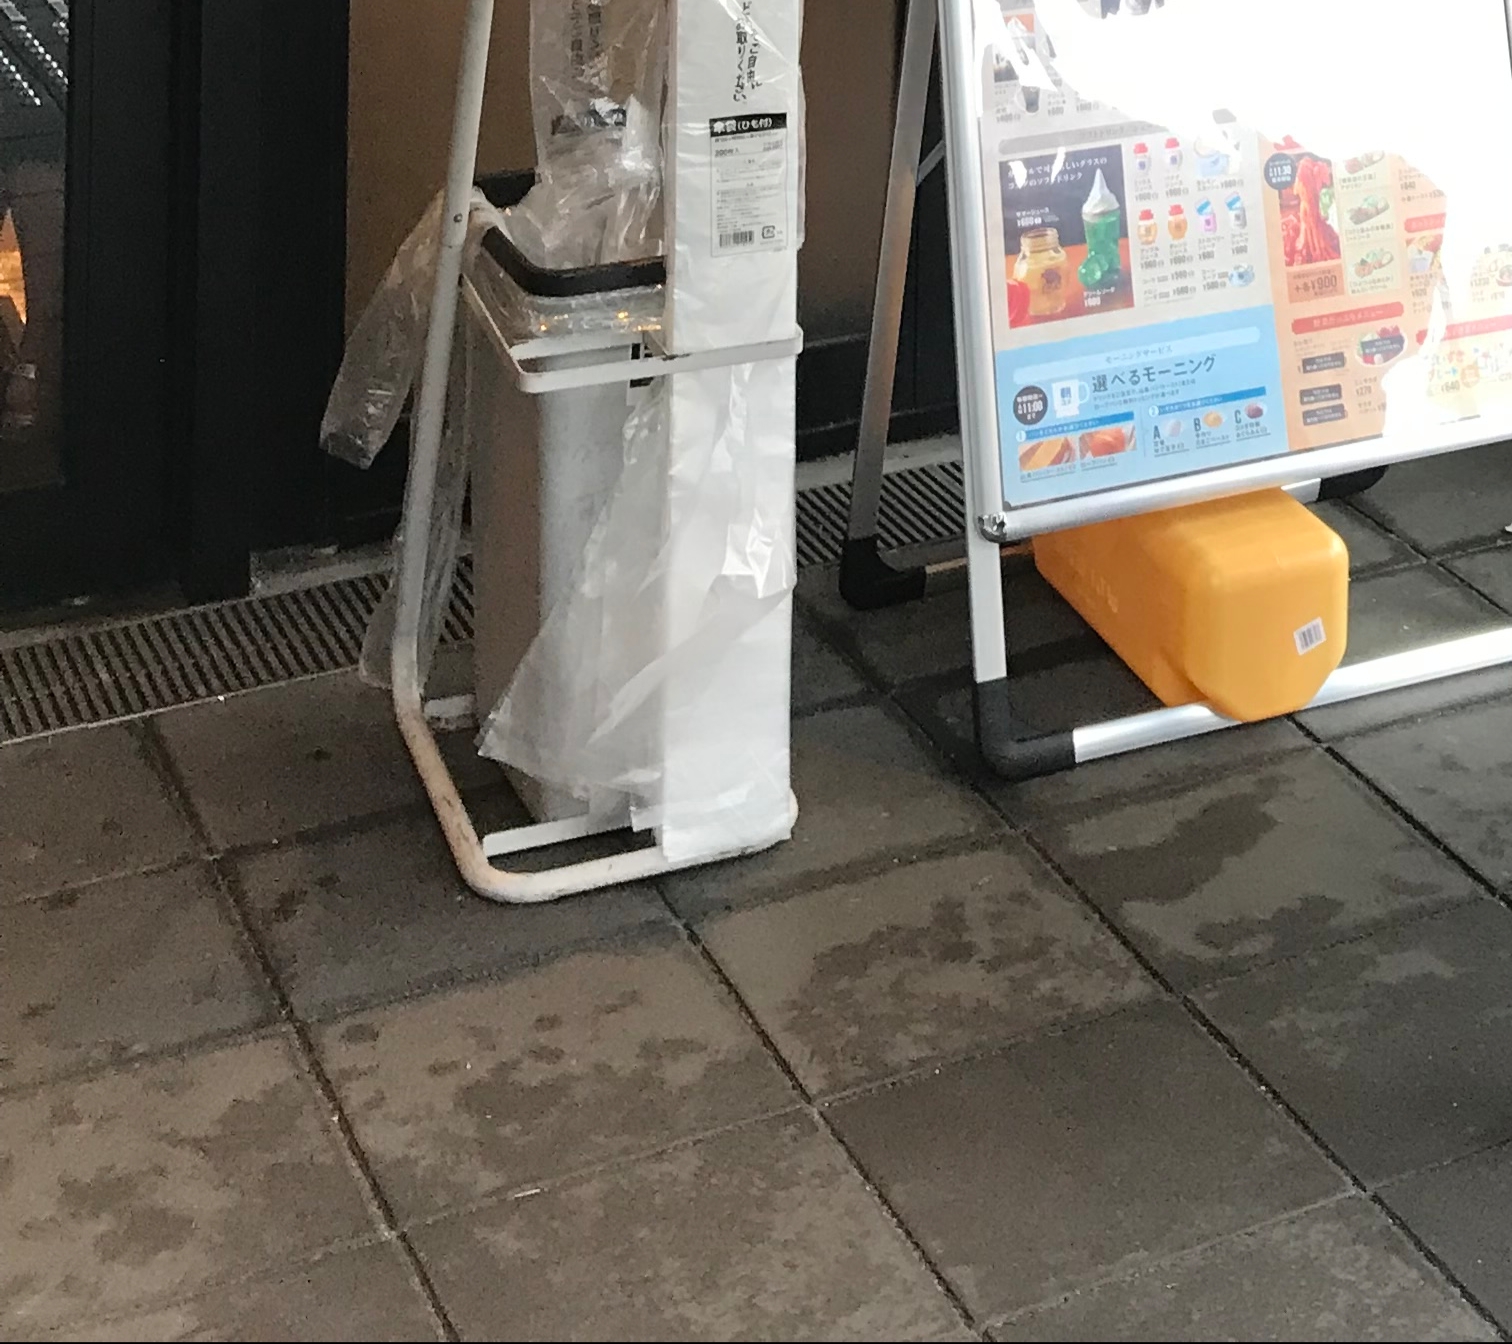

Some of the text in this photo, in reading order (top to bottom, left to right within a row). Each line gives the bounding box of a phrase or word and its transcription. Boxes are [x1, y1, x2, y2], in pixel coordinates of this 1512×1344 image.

[1091, 353, 1217, 393] 選べるモーニング
[1234, 410, 1242, 424] C
[1194, 418, 1201, 432] B
[1153, 425, 1161, 440] A
